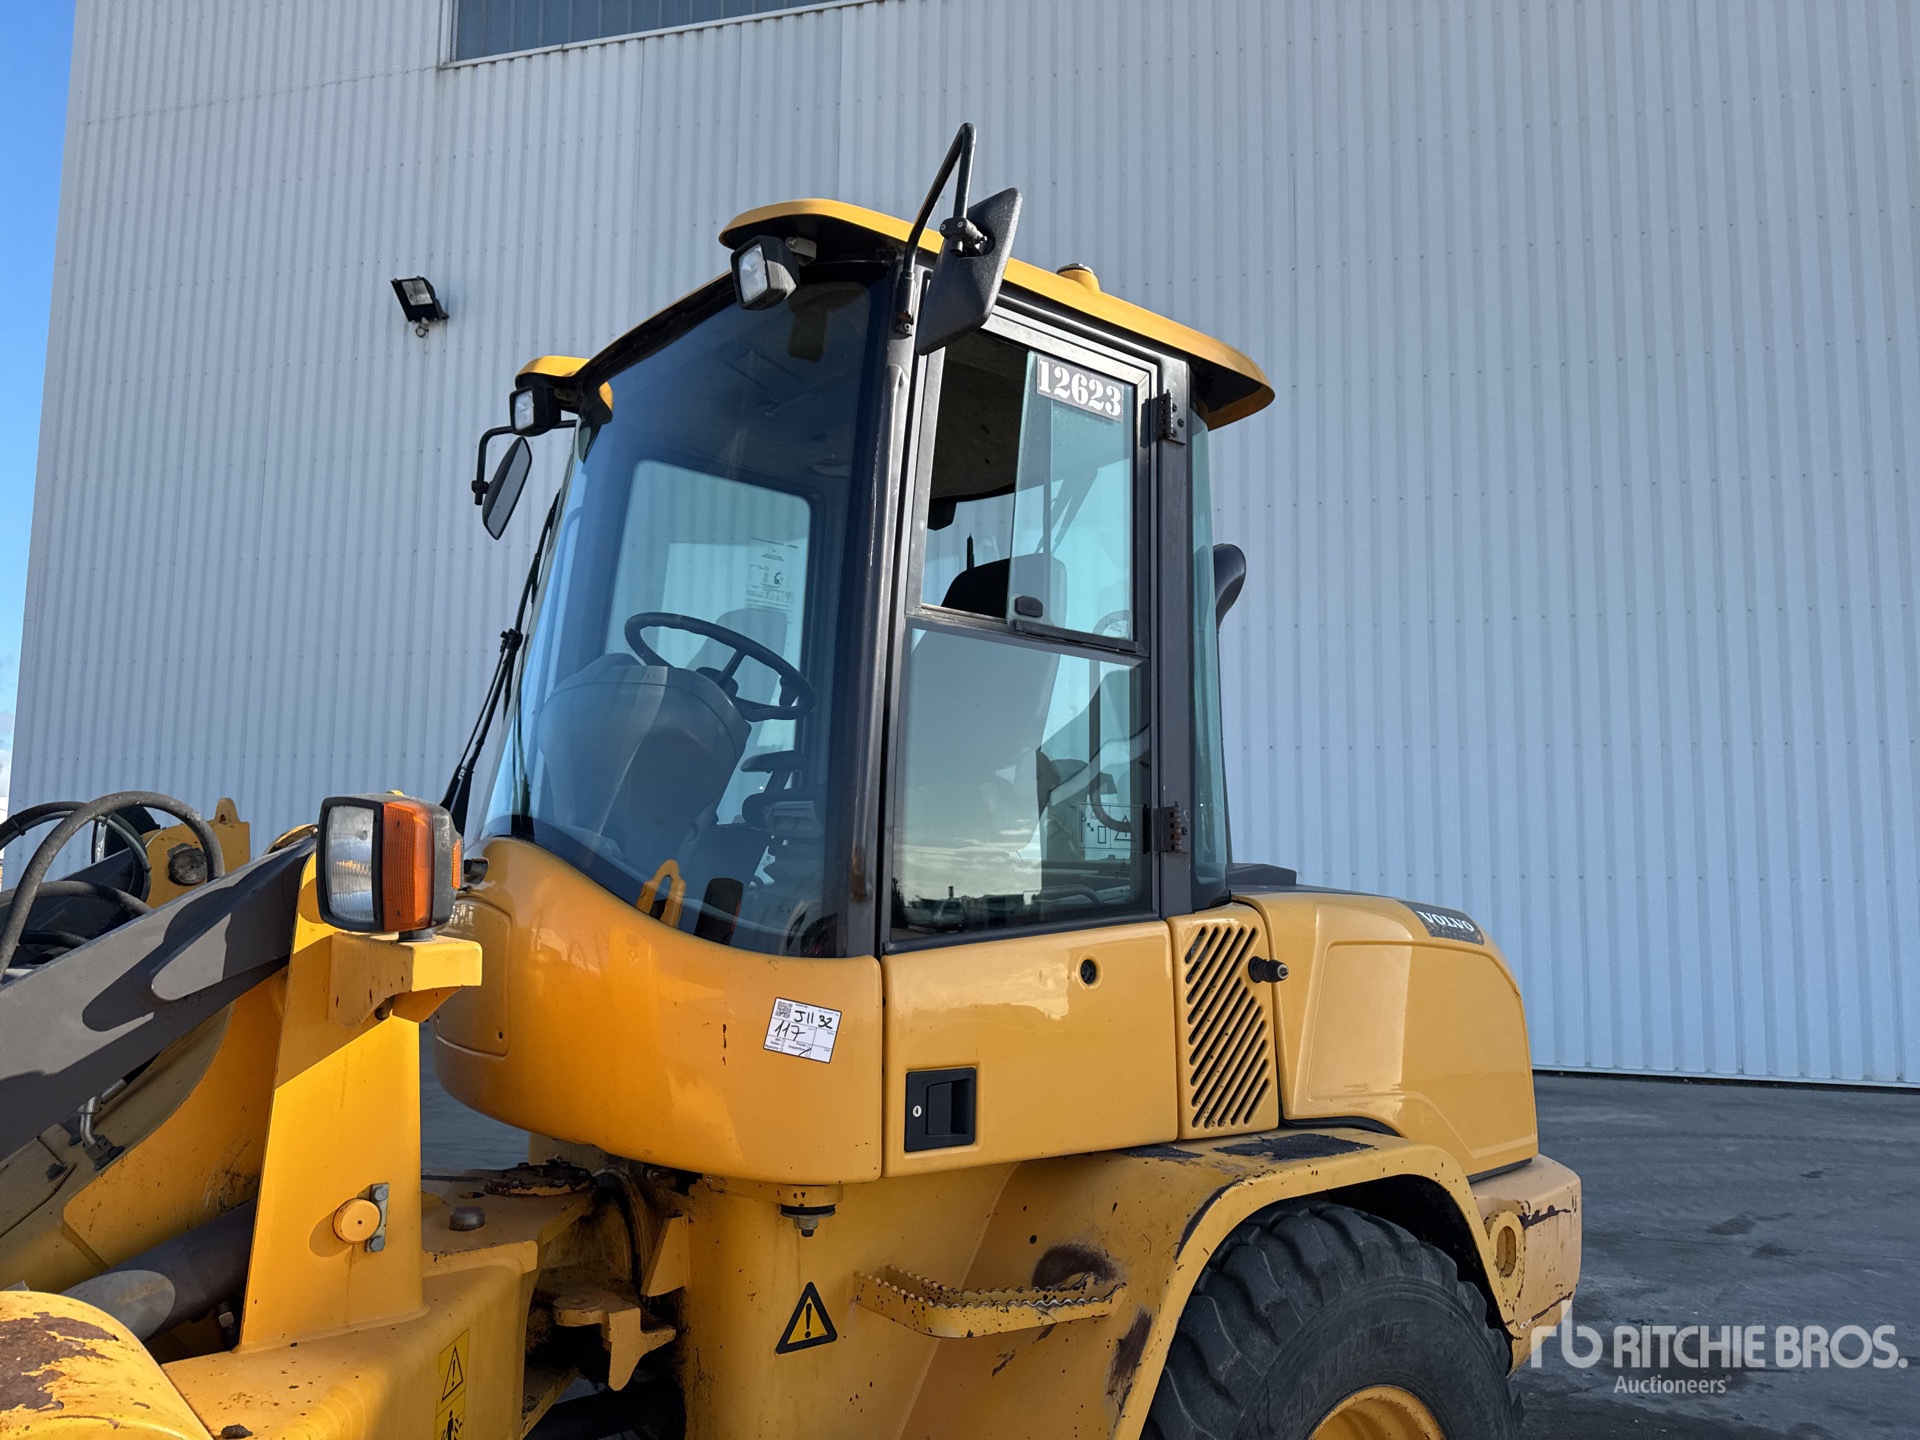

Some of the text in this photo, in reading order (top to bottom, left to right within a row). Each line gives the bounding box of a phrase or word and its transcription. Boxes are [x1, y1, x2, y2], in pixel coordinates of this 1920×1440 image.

[1039, 359, 1121, 416] 12623
[1416, 910, 1475, 932] VOLVO
[774, 1020, 806, 1041] 117
